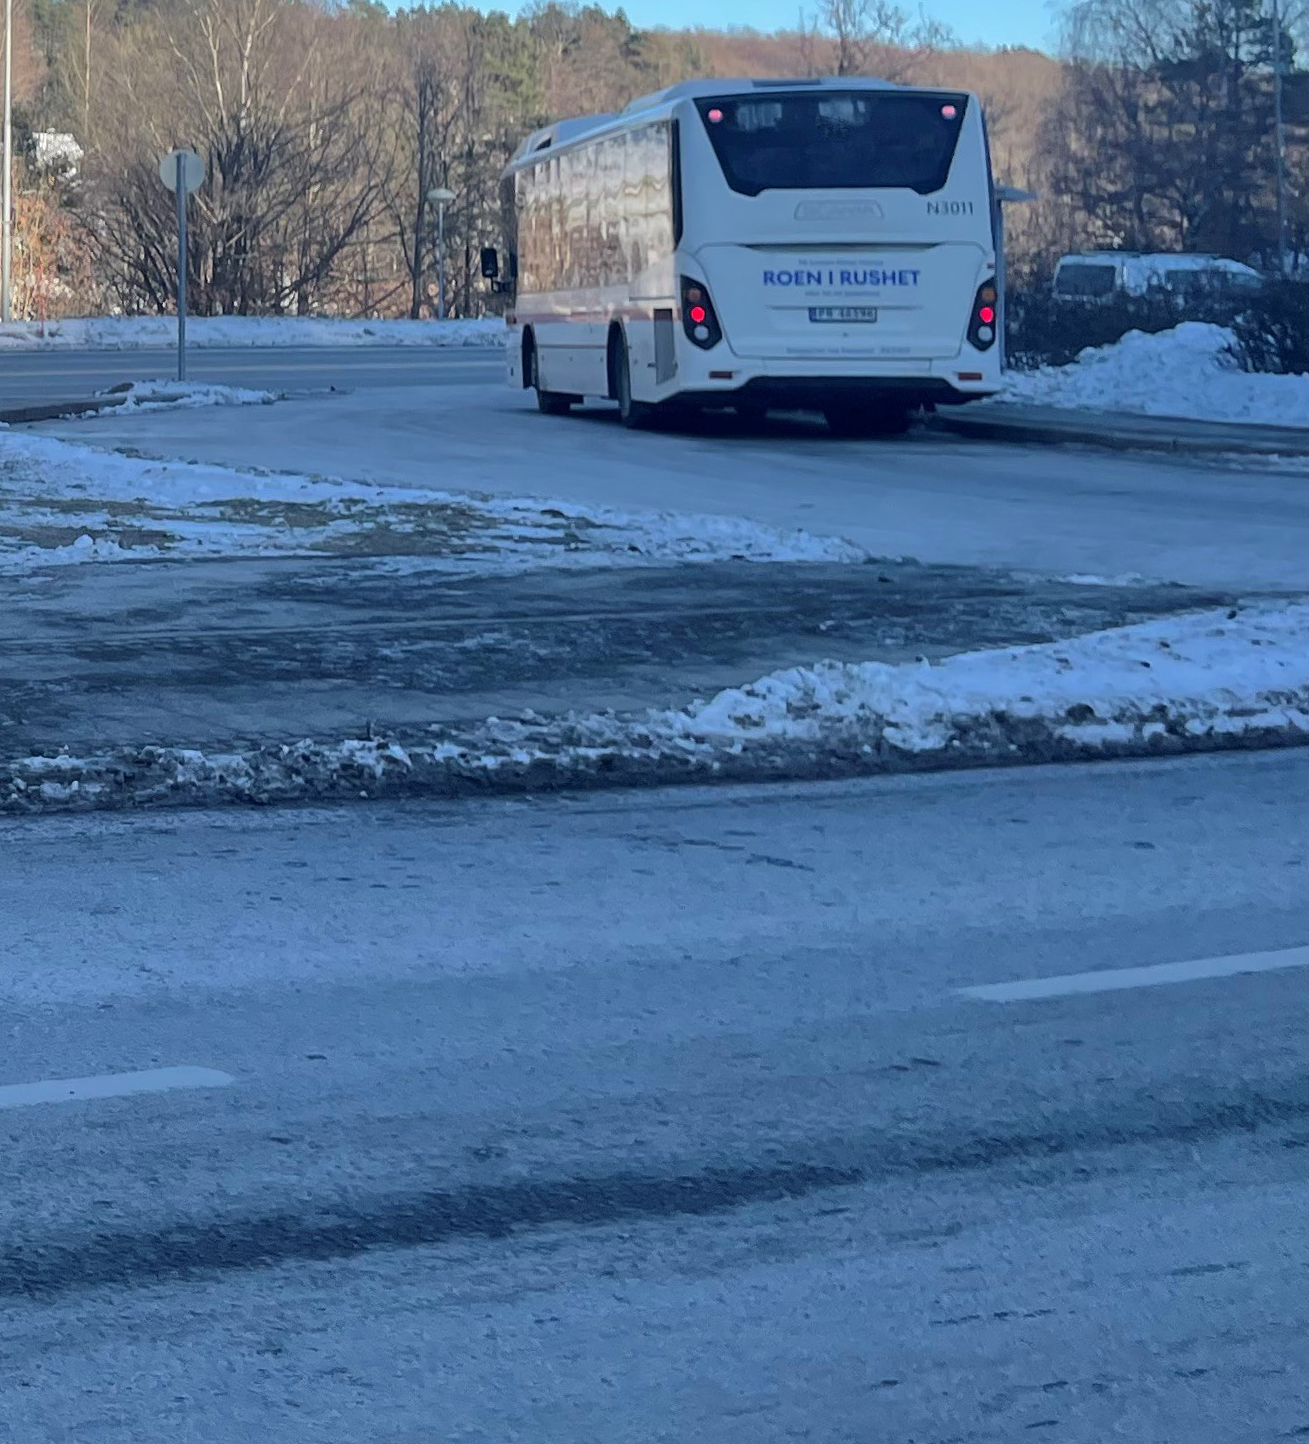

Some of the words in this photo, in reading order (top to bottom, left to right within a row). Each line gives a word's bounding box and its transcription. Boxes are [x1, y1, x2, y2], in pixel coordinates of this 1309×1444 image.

[926, 201, 974, 216] N3011
[763, 270, 822, 286] ROEN
[828, 270, 834, 286] I
[840, 269, 921, 286] RUSHET
